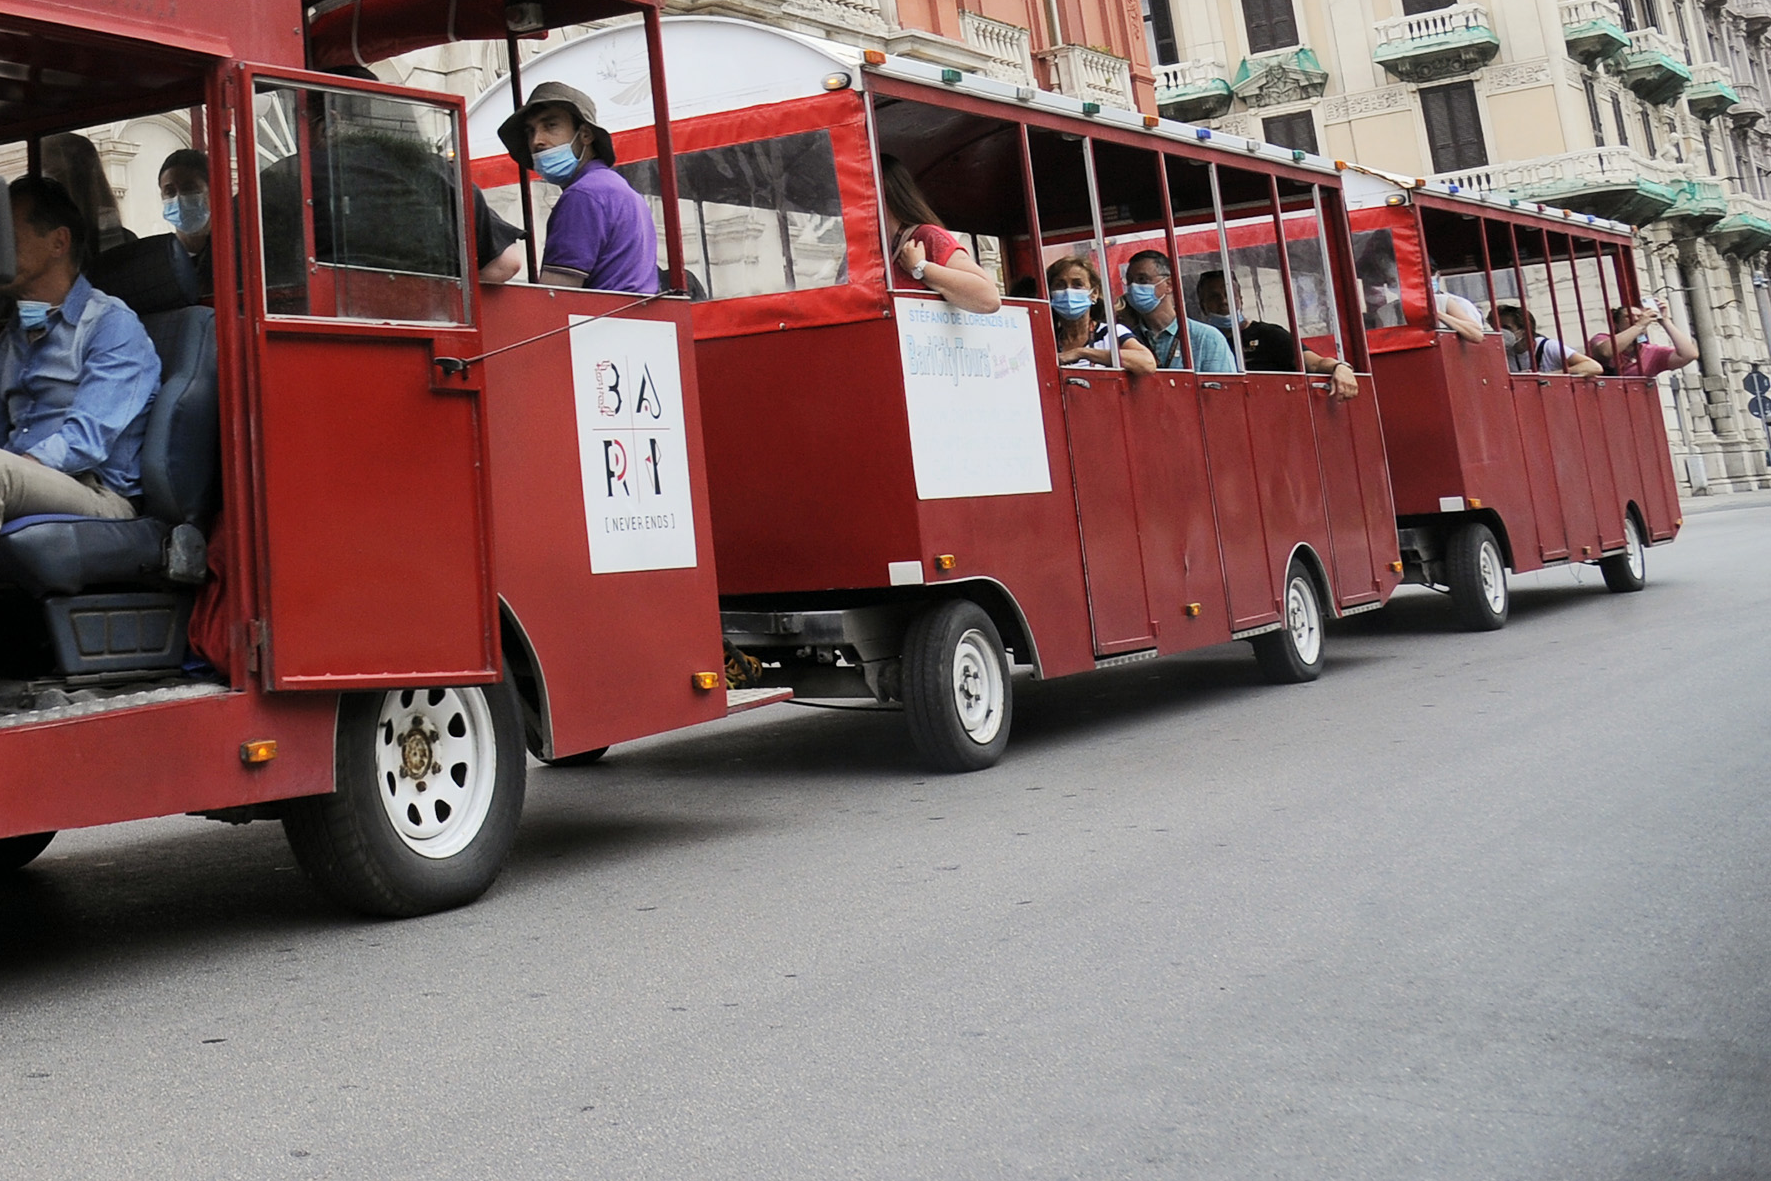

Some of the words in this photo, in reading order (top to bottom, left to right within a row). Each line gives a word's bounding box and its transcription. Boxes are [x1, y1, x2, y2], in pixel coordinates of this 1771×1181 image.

[909, 310, 948, 324] STEFANO
[951, 313, 962, 325] DE
[964, 314, 1003, 327] LORENZIS
